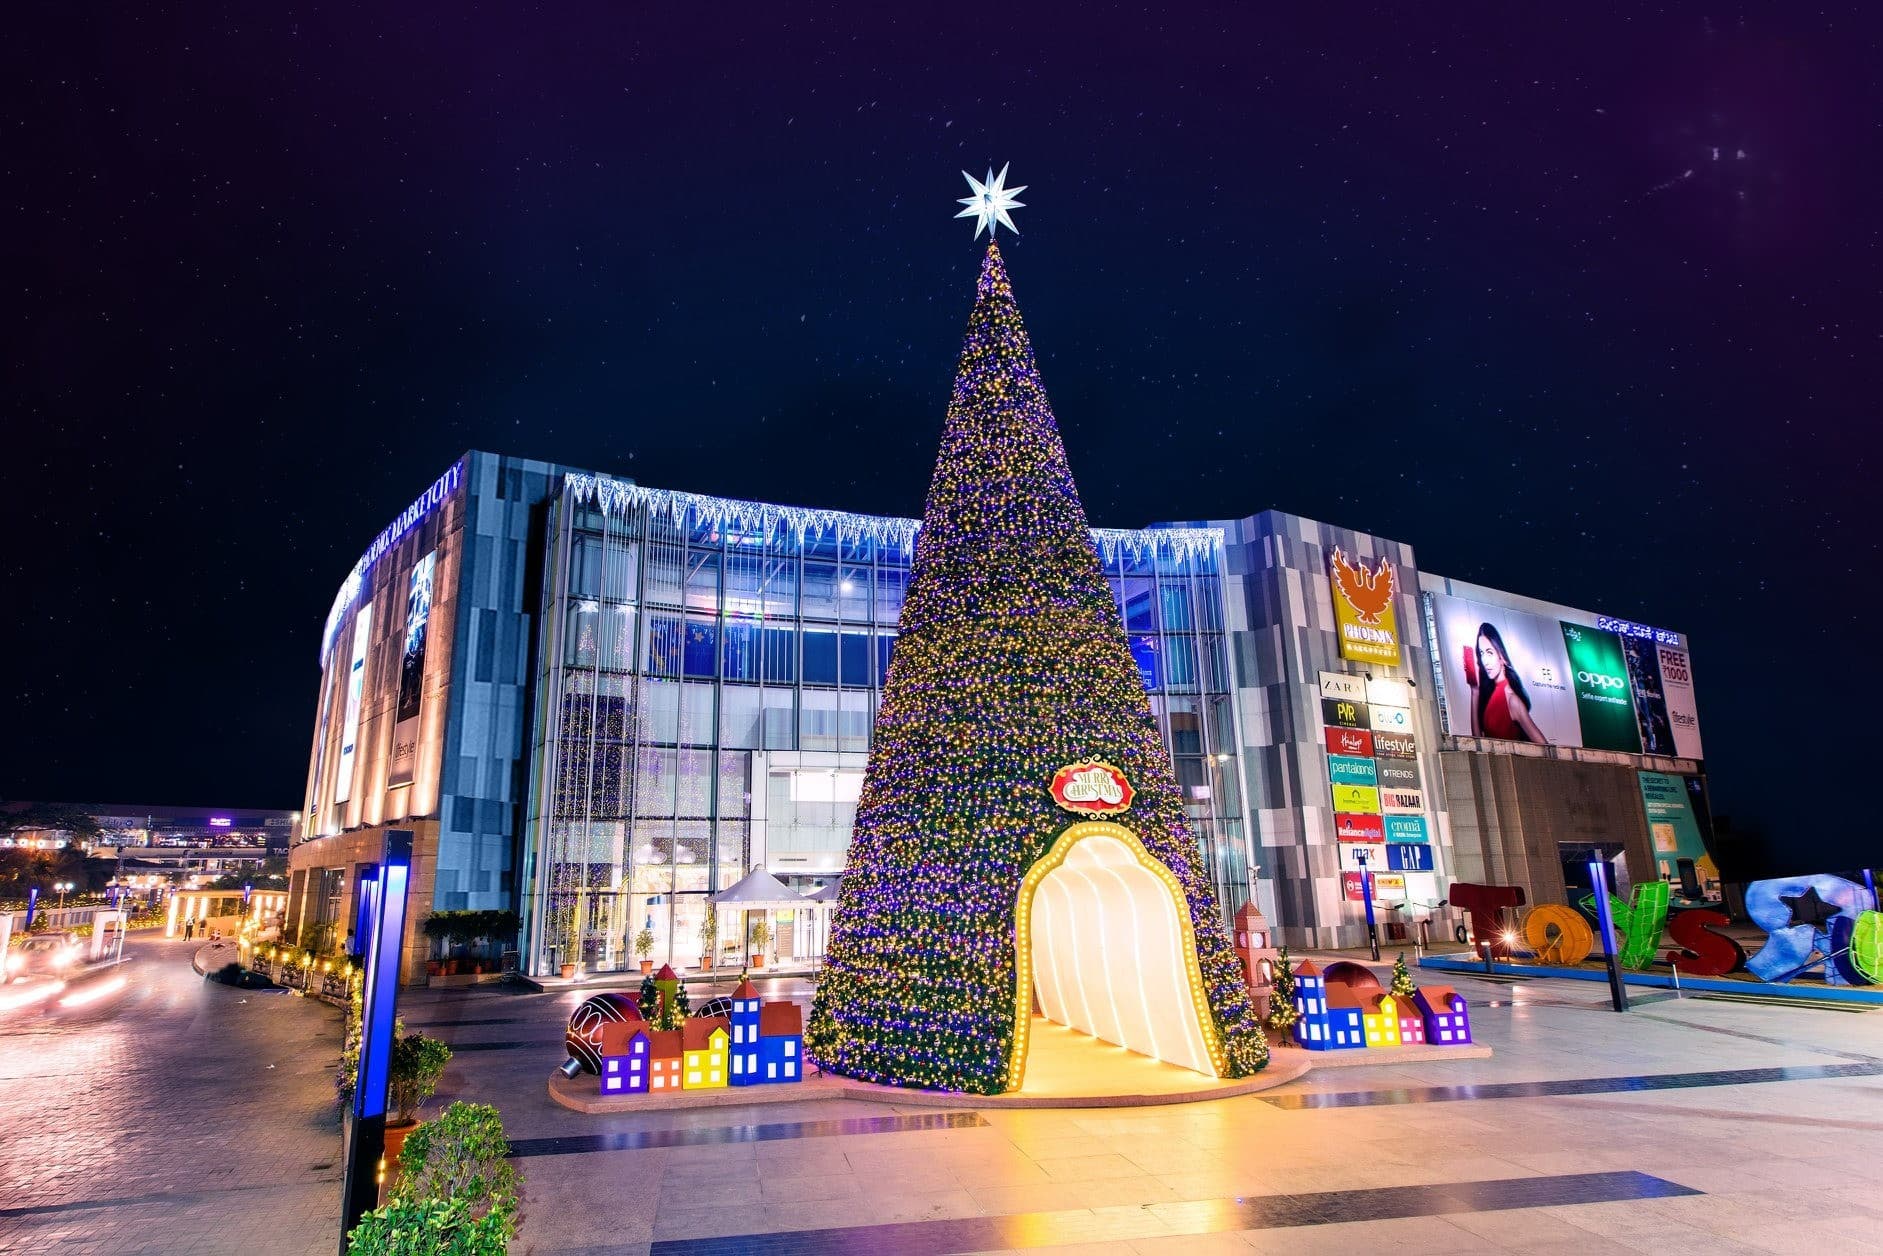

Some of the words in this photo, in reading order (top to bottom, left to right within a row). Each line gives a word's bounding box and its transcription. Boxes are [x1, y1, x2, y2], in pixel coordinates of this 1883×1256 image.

[391, 462, 462, 543] MARKETCITY
[1660, 649, 1686, 667] FREE
[1325, 681, 1361, 693] ZARA
[1577, 670, 1624, 689] oppo
[1337, 702, 1356, 721] PVR
[1374, 734, 1415, 755] lifestyle
[1332, 762, 1374, 776] pantaloons
[1388, 770, 1414, 779] TRENDS
[1078, 771, 1110, 784] MERRY
[1065, 783, 1122, 799] CHRISTMAS
[1384, 793, 1395, 807] BIG
[1396, 794, 1421, 808] BAZAAR
[1352, 848, 1375, 860] max
[1400, 845, 1421, 870] GAP
